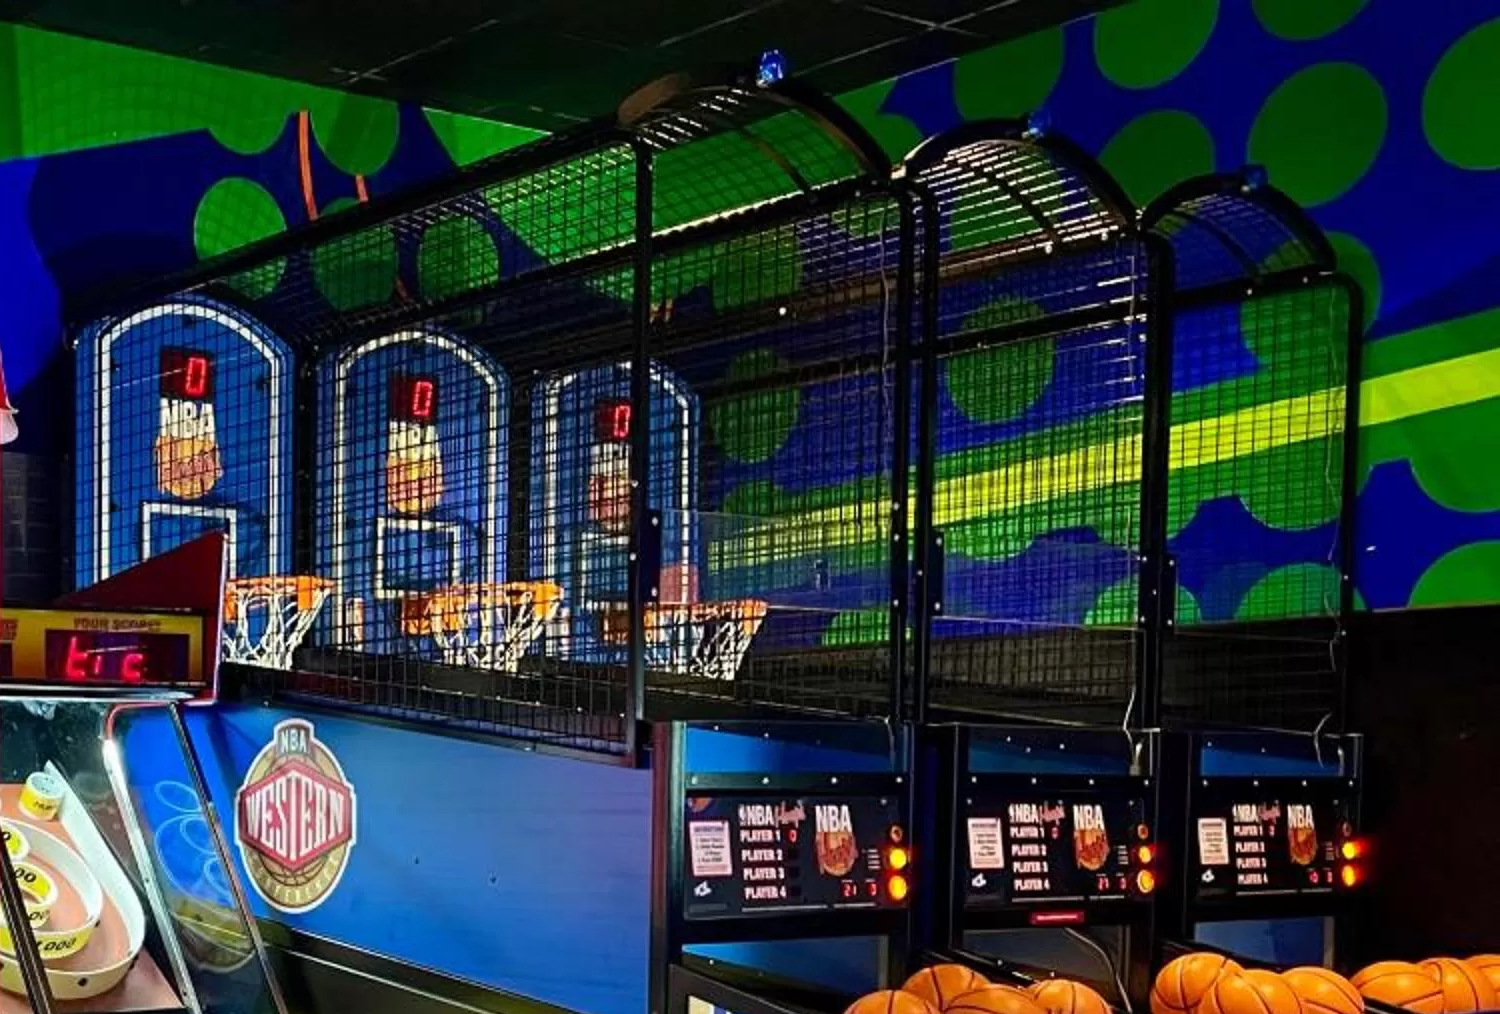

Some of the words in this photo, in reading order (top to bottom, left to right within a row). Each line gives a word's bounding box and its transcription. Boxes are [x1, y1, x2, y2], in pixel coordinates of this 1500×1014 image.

[185, 356, 207, 395] 0
[412, 381, 433, 416] 0
[160, 398, 216, 439] NBA
[613, 405, 631, 437] 0
[280, 729, 308, 754] NBA
[246, 769, 345, 862] WESTERN
[815, 804, 853, 832] NBA
[1073, 804, 1105, 830] NBA
[1287, 804, 1315, 828] NBA
[740, 829, 774, 842] PLAYER
[741, 849, 775, 861] PLAYER
[743, 868, 777, 880] PLAYER
[745, 886, 779, 899] PLAYER
